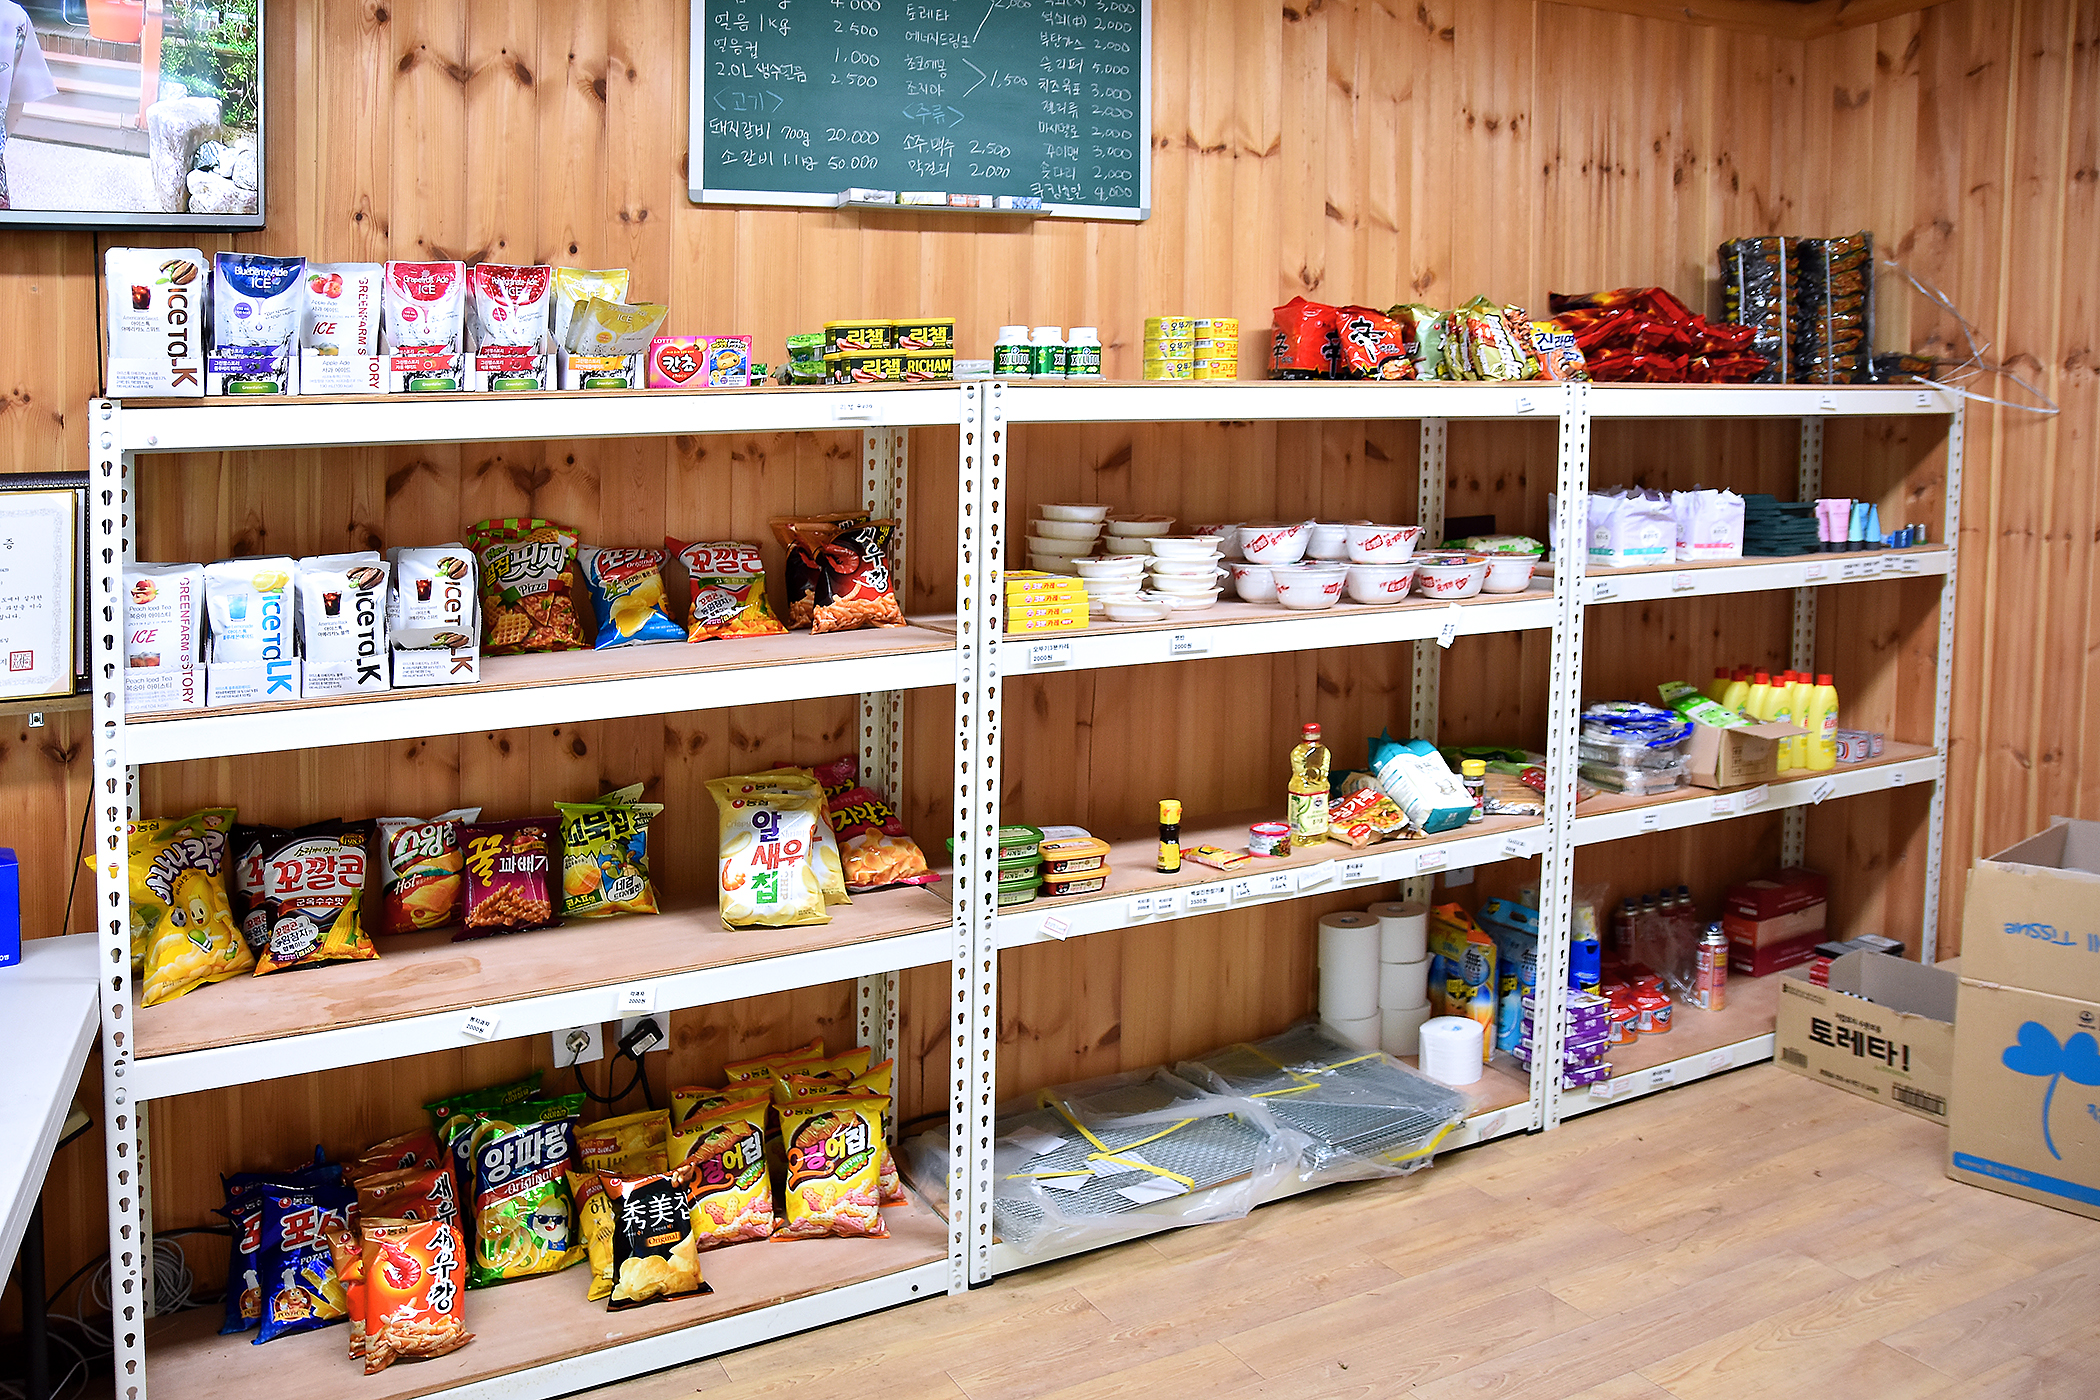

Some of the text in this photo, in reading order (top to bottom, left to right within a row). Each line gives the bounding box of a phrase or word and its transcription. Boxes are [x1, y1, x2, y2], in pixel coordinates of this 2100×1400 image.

[714, 11, 750, 32] 얼음
[905, 3, 949, 21] 토레타
[1093, 17, 1132, 33] 2,000
[713, 37, 759, 60] 얼음컵
[1040, 31, 1131, 53] 부탄가스 2,000
[904, 53, 1028, 89] 초코에몽 1,500
[1039, 56, 1083, 73] 슬리퍼
[905, 80, 945, 97] 조지아
[1090, 83, 1132, 102] 3,000
[709, 117, 771, 141] 돼지갈비
[1091, 126, 1133, 140] 2,000
[968, 140, 1011, 158] 2,500
[1092, 145, 1133, 160] 3,000
[908, 158, 950, 178] 막걸리
[1092, 165, 1132, 180] 2,000
[251, 279, 272, 289] ICE
[418, 284, 436, 295] ICE
[312, 321, 338, 335] ICE
[616, 313, 634, 323] ICE
[847, 328, 885, 345] 리챔
[909, 326, 949, 343] 리챔
[862, 358, 902, 375] 리챔
[907, 358, 952, 373] RICHAM
[684, 548, 765, 574] 꼬깔콘
[855, 525, 889, 593] 새우깡
[484, 554, 511, 587] 벌집
[518, 582, 548, 596] Pizza
[131, 628, 159, 644] ICE
[752, 810, 783, 843] 알
[391, 821, 457, 869] 스윙칩
[751, 839, 804, 870] 새우
[144, 828, 226, 907] 바나나킥
[466, 833, 504, 887] 꿀
[498, 853, 549, 874] 꽈배기
[272, 854, 364, 893] 꼬깔콘
[393, 873, 422, 896] Hot
[751, 870, 778, 905] 칩
[296, 897, 345, 907] 군옥수수맛
[2003, 922, 2077, 947] Tissue
[1808, 1016, 1910, 1072] 토레타!
[484, 1122, 569, 1183] 양파링
[787, 1123, 868, 1193] 오징어집
[506, 1168, 554, 1195] Original
[648, 1232, 681, 1244] Original
[425, 1222, 459, 1314] 새우깡
